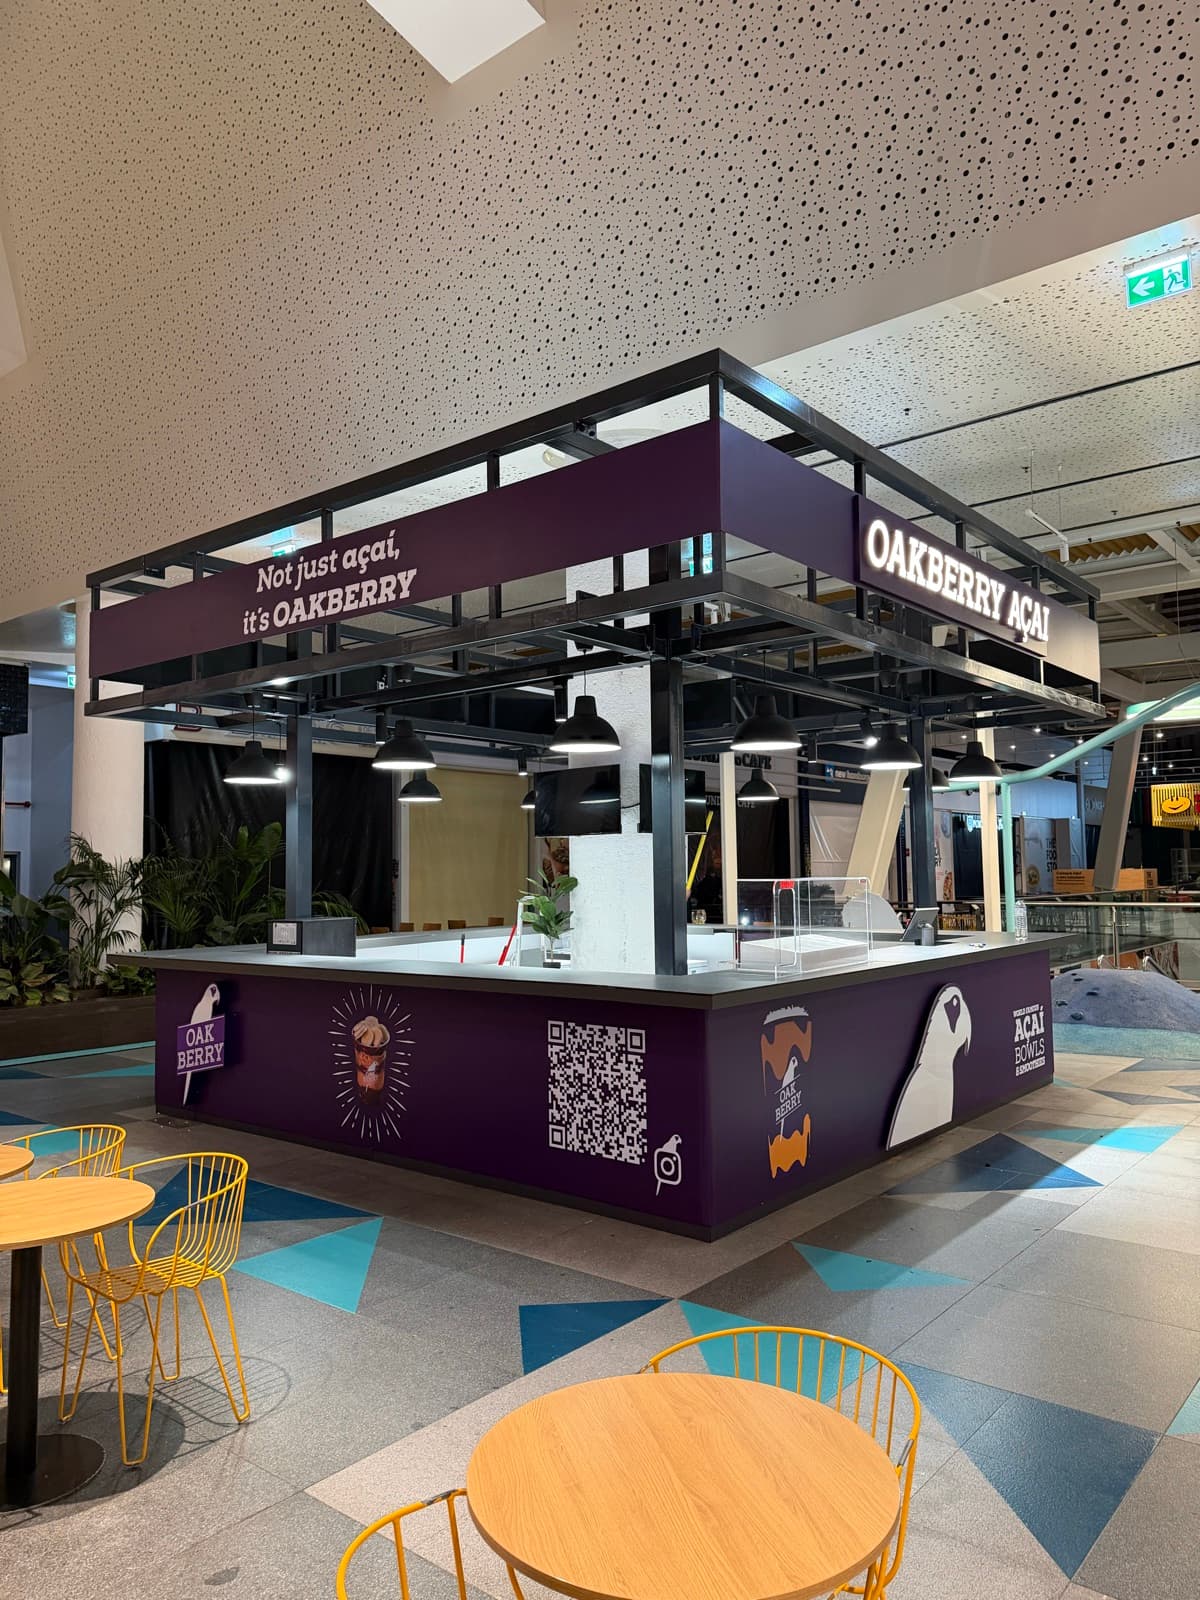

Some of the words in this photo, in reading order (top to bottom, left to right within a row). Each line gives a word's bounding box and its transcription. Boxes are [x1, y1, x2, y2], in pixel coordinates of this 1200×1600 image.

[256, 562, 293, 593] Not
[294, 550, 339, 591] just
[342, 529, 400, 574] açaí,
[867, 519, 1006, 621] OAKBERRY
[243, 607, 270, 635] it's
[273, 568, 417, 627] OAKBERRY
[186, 1023, 215, 1047] OAK
[1014, 1006, 1045, 1045] AÇAÍ
[177, 1042, 224, 1070] BERRY
[1015, 1039, 1045, 1064] BOWLS
[775, 1090, 802, 1121] BERRY
[779, 1081, 797, 1104] OAK
